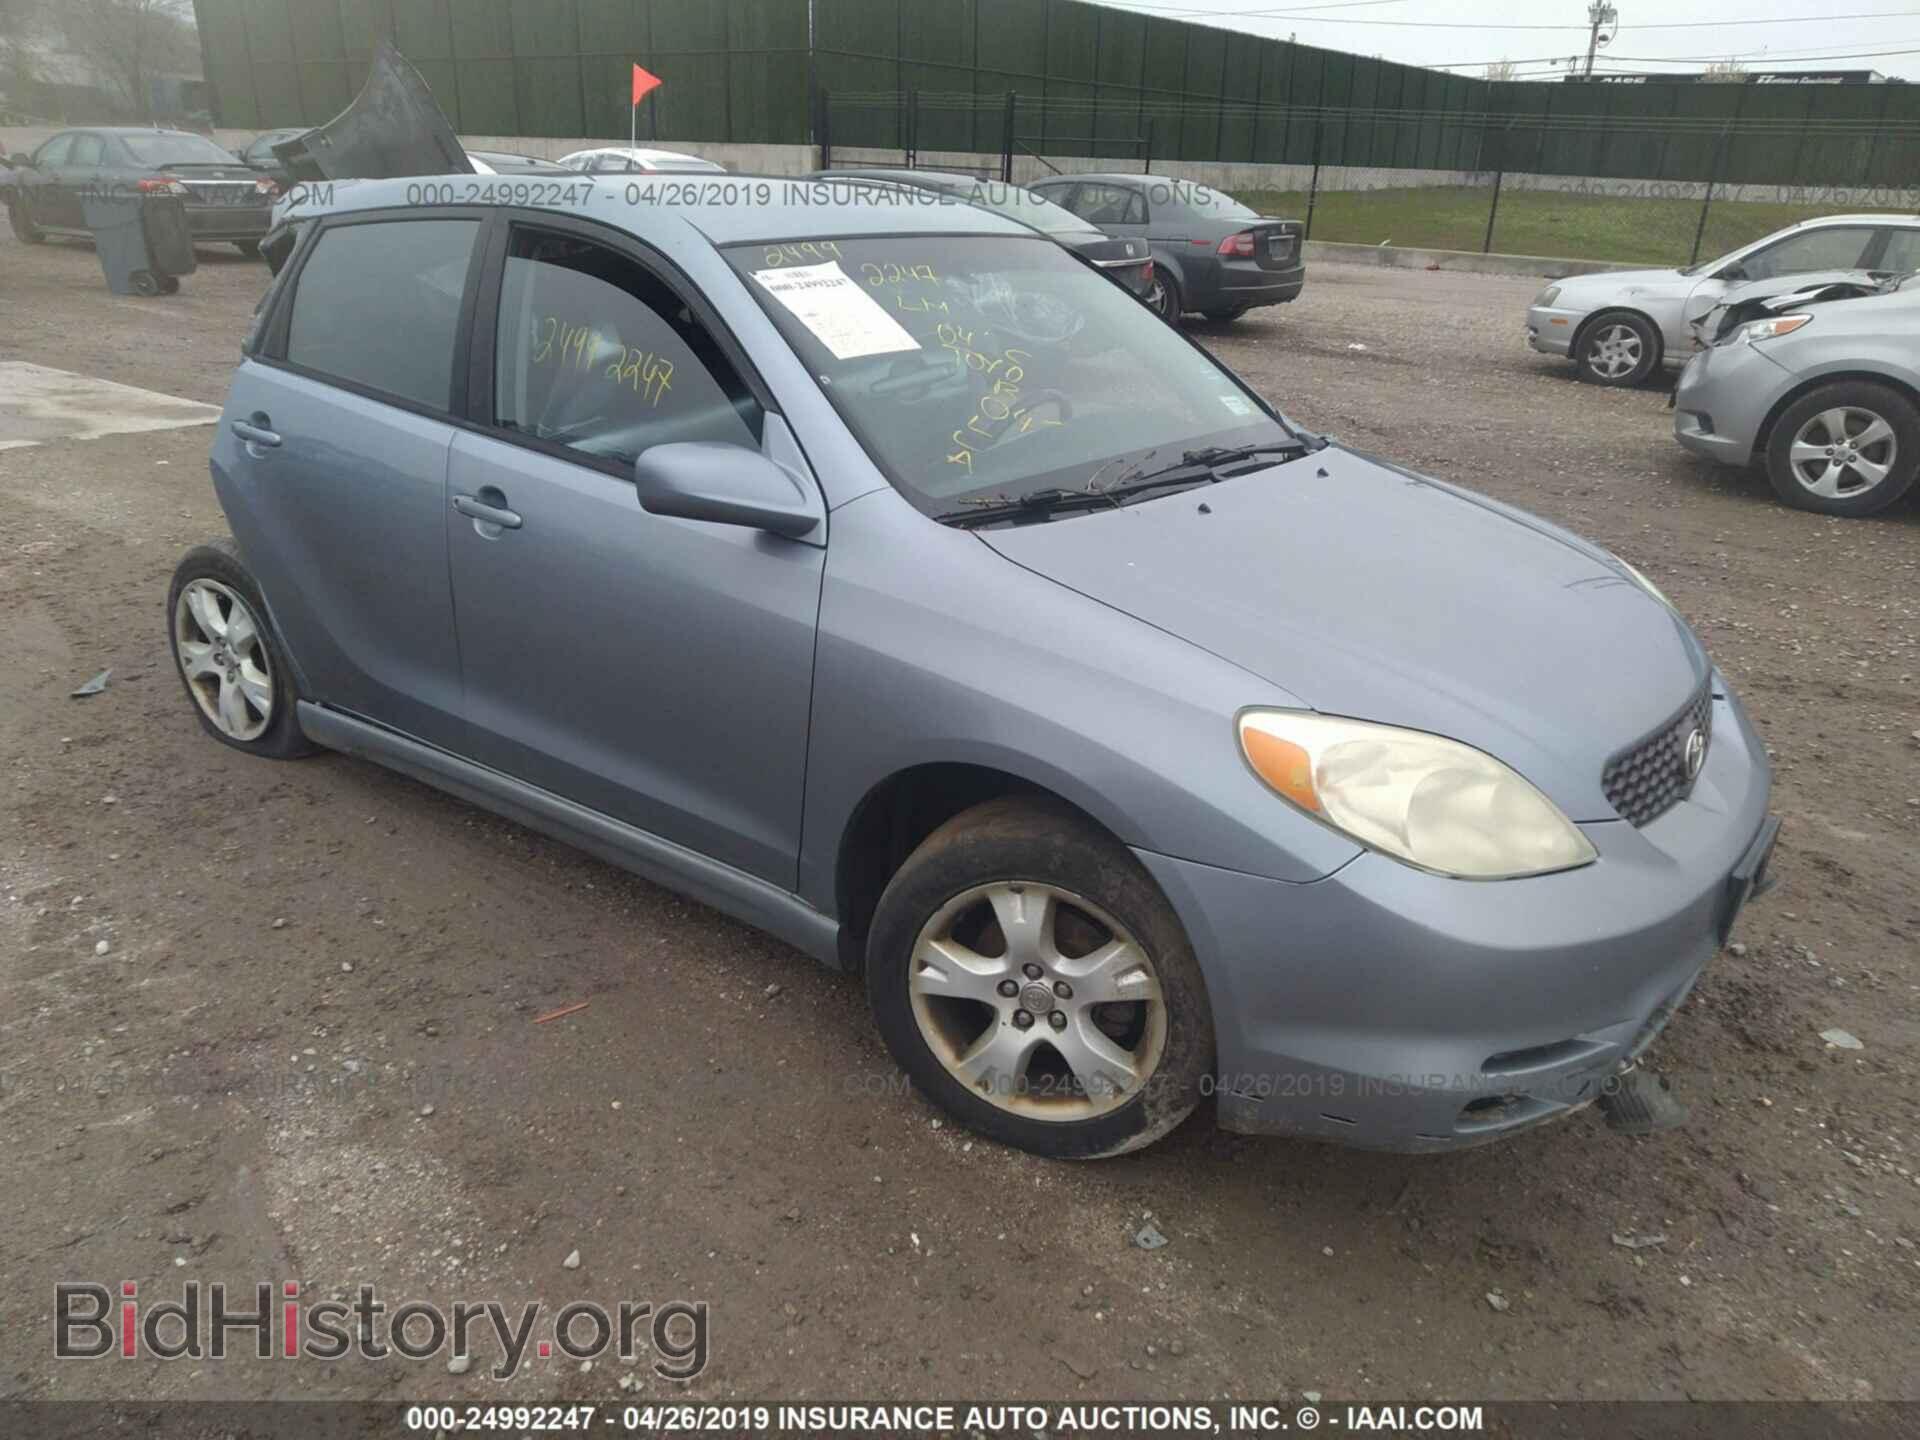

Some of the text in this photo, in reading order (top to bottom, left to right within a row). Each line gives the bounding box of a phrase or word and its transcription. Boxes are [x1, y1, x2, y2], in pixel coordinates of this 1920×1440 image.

[763, 241, 842, 267] 2499
[860, 263, 940, 287] 2247
[605, 344, 674, 408] 2247
